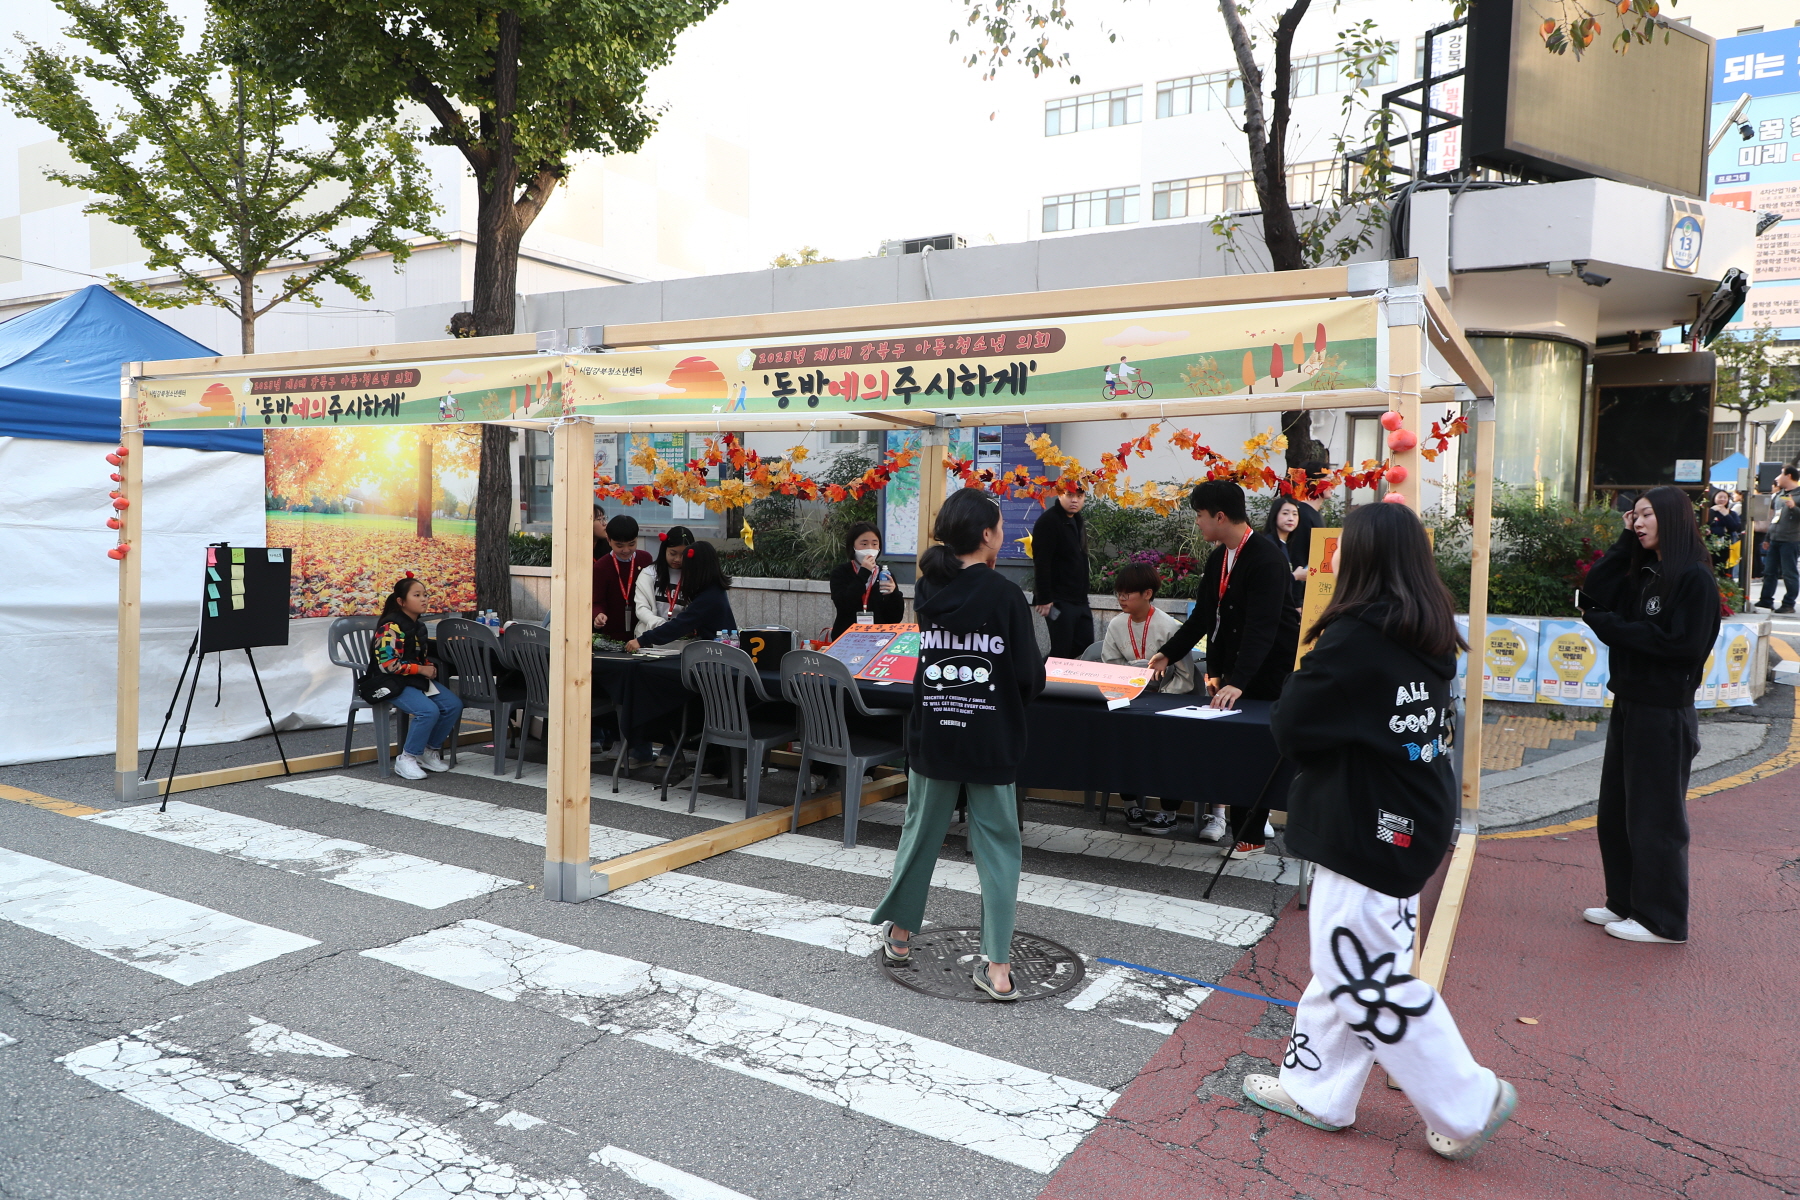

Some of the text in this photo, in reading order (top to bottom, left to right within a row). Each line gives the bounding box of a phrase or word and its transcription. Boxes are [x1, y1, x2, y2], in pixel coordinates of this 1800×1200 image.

[1723, 52, 1785, 84] 되는
[1759, 118, 1784, 141] 꿈
[1738, 142, 1788, 166] 미래
[1717, 174, 1747, 183] 프로그램
[1679, 236, 1693, 251] 13
[759, 331, 1051, 364] 2023년 제6대 강북구 아동·청소년 의회
[254, 371, 414, 391] 2023년 제6대 강북구 아동·청소년 의회
[1396, 682, 1430, 706] ALL
